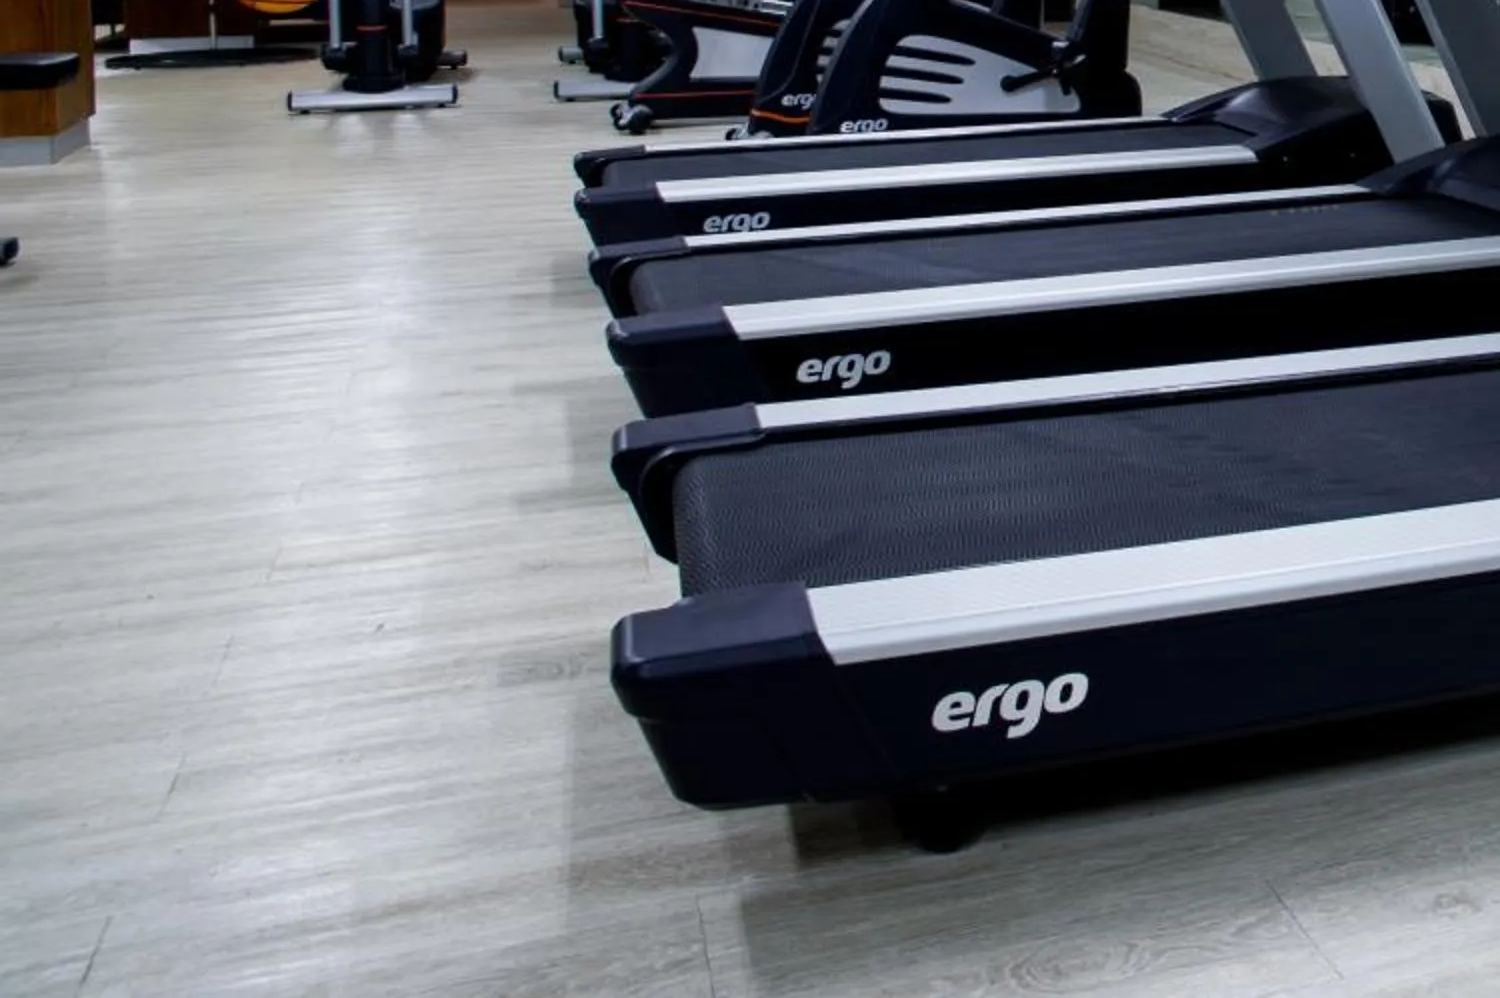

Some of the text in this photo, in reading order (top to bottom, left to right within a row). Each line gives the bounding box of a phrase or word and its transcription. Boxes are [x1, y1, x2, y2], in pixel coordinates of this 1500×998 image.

[781, 93, 816, 110] erg
[703, 212, 771, 233] ergo
[796, 350, 891, 389] ergo
[931, 672, 1089, 739] ergo
